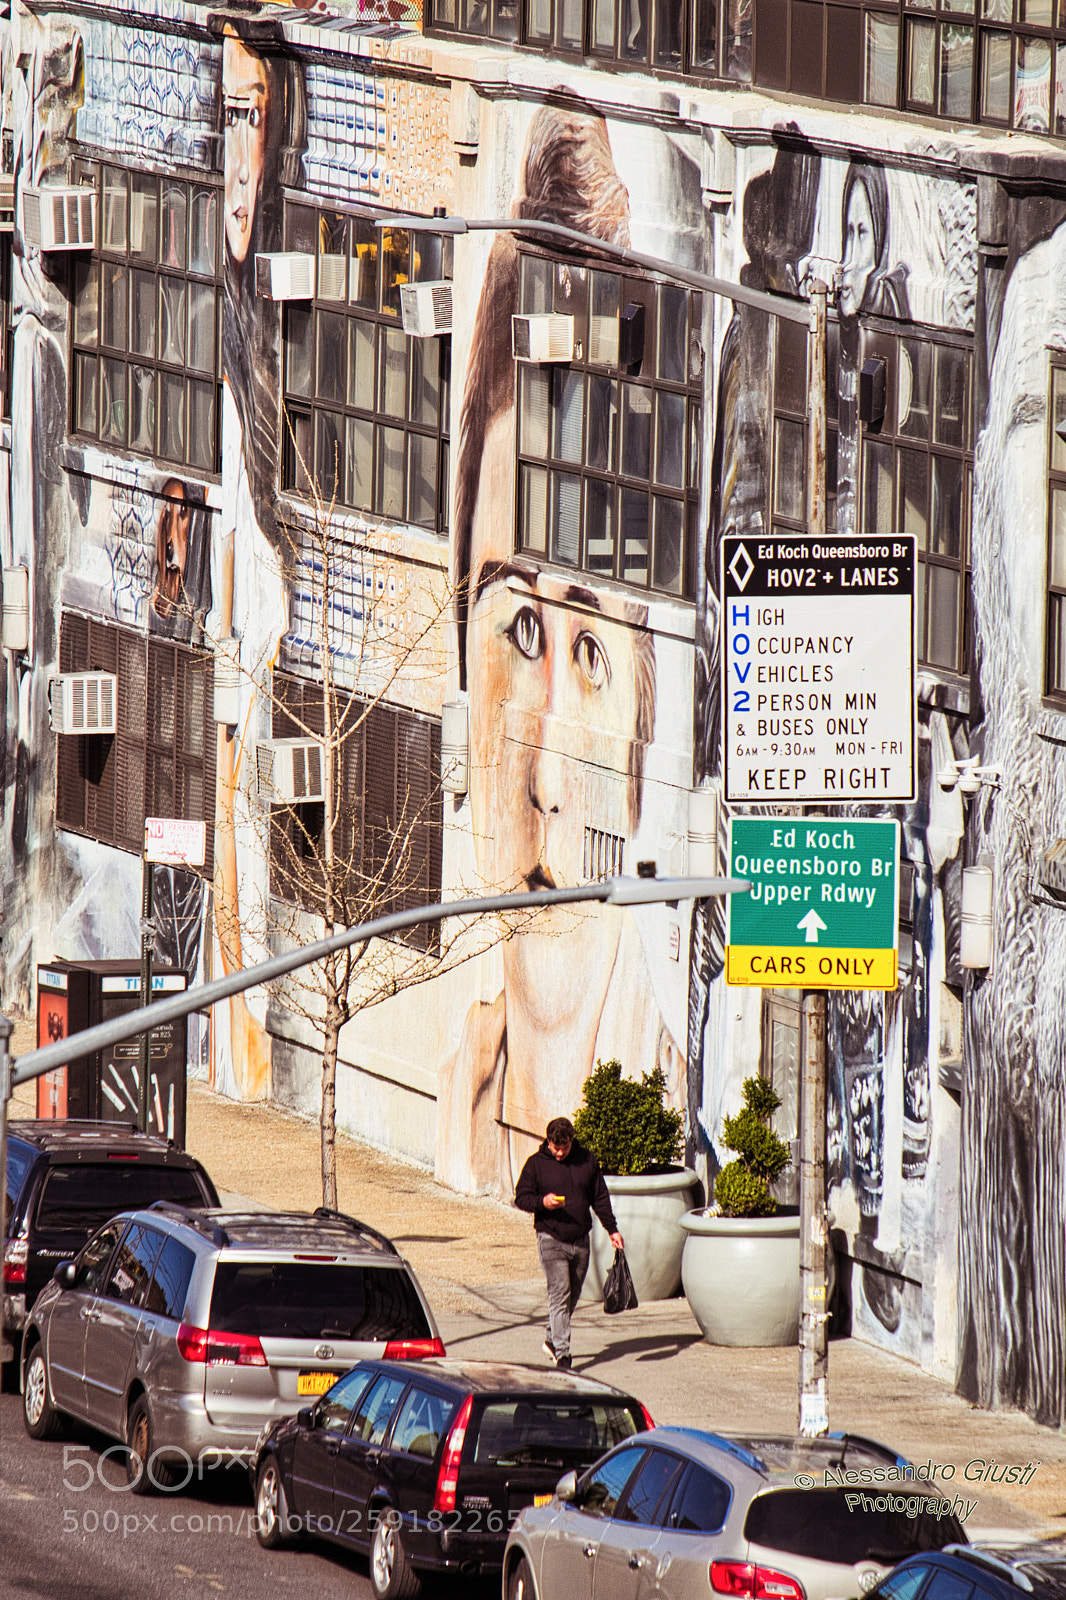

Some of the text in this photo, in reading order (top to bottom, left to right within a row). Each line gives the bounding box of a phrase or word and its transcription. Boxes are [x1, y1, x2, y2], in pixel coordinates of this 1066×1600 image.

[758, 543, 908, 559] Ed Koch Queensboro Br
[840, 567, 899, 586] LANES
[733, 691, 876, 712] 2 PERSON MIN
[736, 718, 868, 736] & BUSES ONLY
[748, 768, 891, 790] KEEP RIGHT
[147, 821, 199, 838] NO PARKING
[773, 828, 855, 849] Ed Koch
[735, 855, 892, 877] Queensboro Br
[751, 882, 876, 908] Upper Rdwy
[750, 956, 875, 975] CARS ONLY
[46, 973, 61, 986] TITAN
